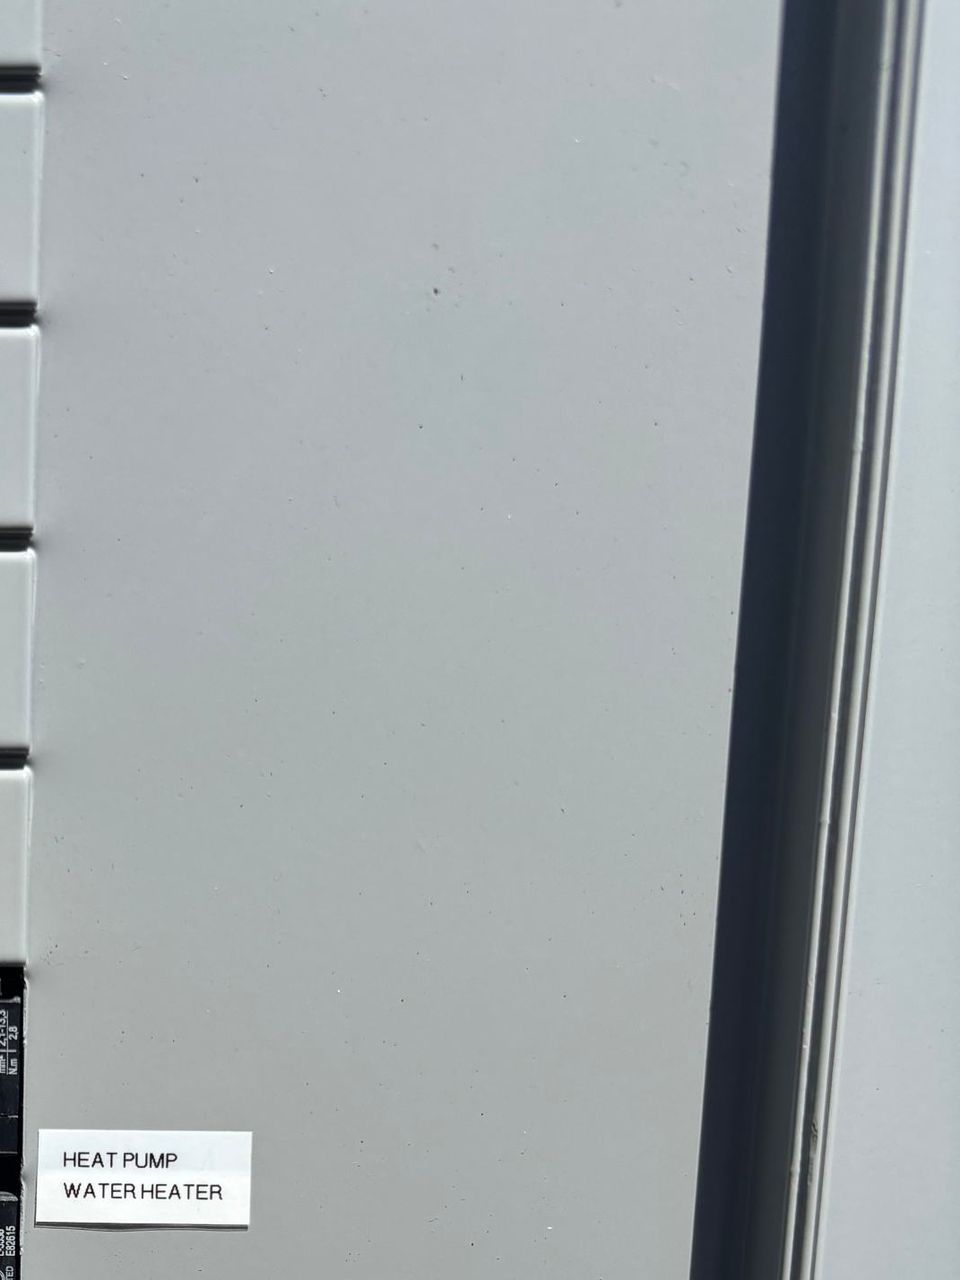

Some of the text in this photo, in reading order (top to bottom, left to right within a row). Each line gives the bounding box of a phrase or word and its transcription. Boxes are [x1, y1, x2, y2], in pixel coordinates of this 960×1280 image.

[9, 1026, 18, 1040] 2,8
[63, 1152, 178, 1169] HEAT PUMP
[64, 1182, 223, 1201] WATER HEATER
[6, 1226, 15, 1256] E82615
